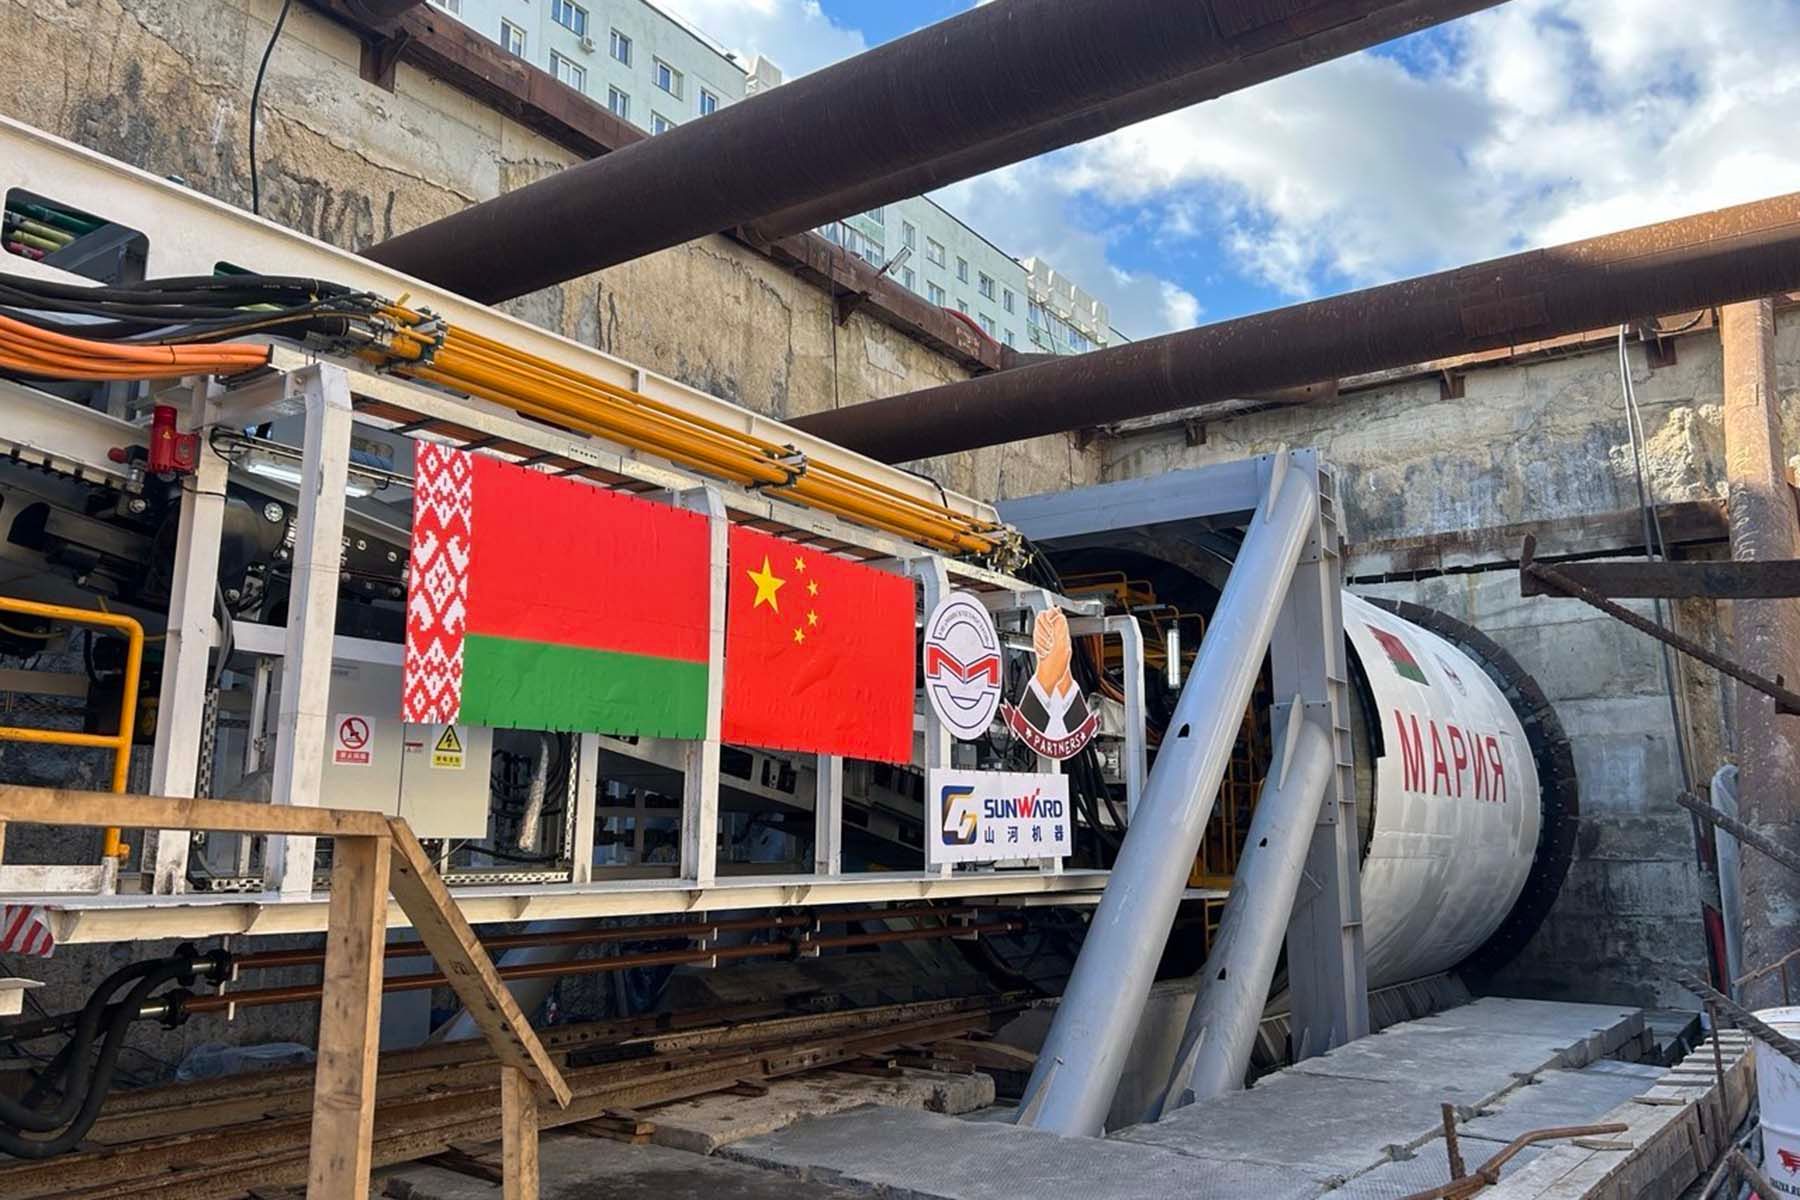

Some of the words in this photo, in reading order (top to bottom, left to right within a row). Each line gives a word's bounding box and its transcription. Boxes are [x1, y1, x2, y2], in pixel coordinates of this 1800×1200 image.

[1033, 733, 1080, 756] PARTNERS
[1394, 709, 1507, 803] МАРИЯ
[984, 788, 1063, 818] SUNWARD
[984, 824, 1064, 844] 山河机器
